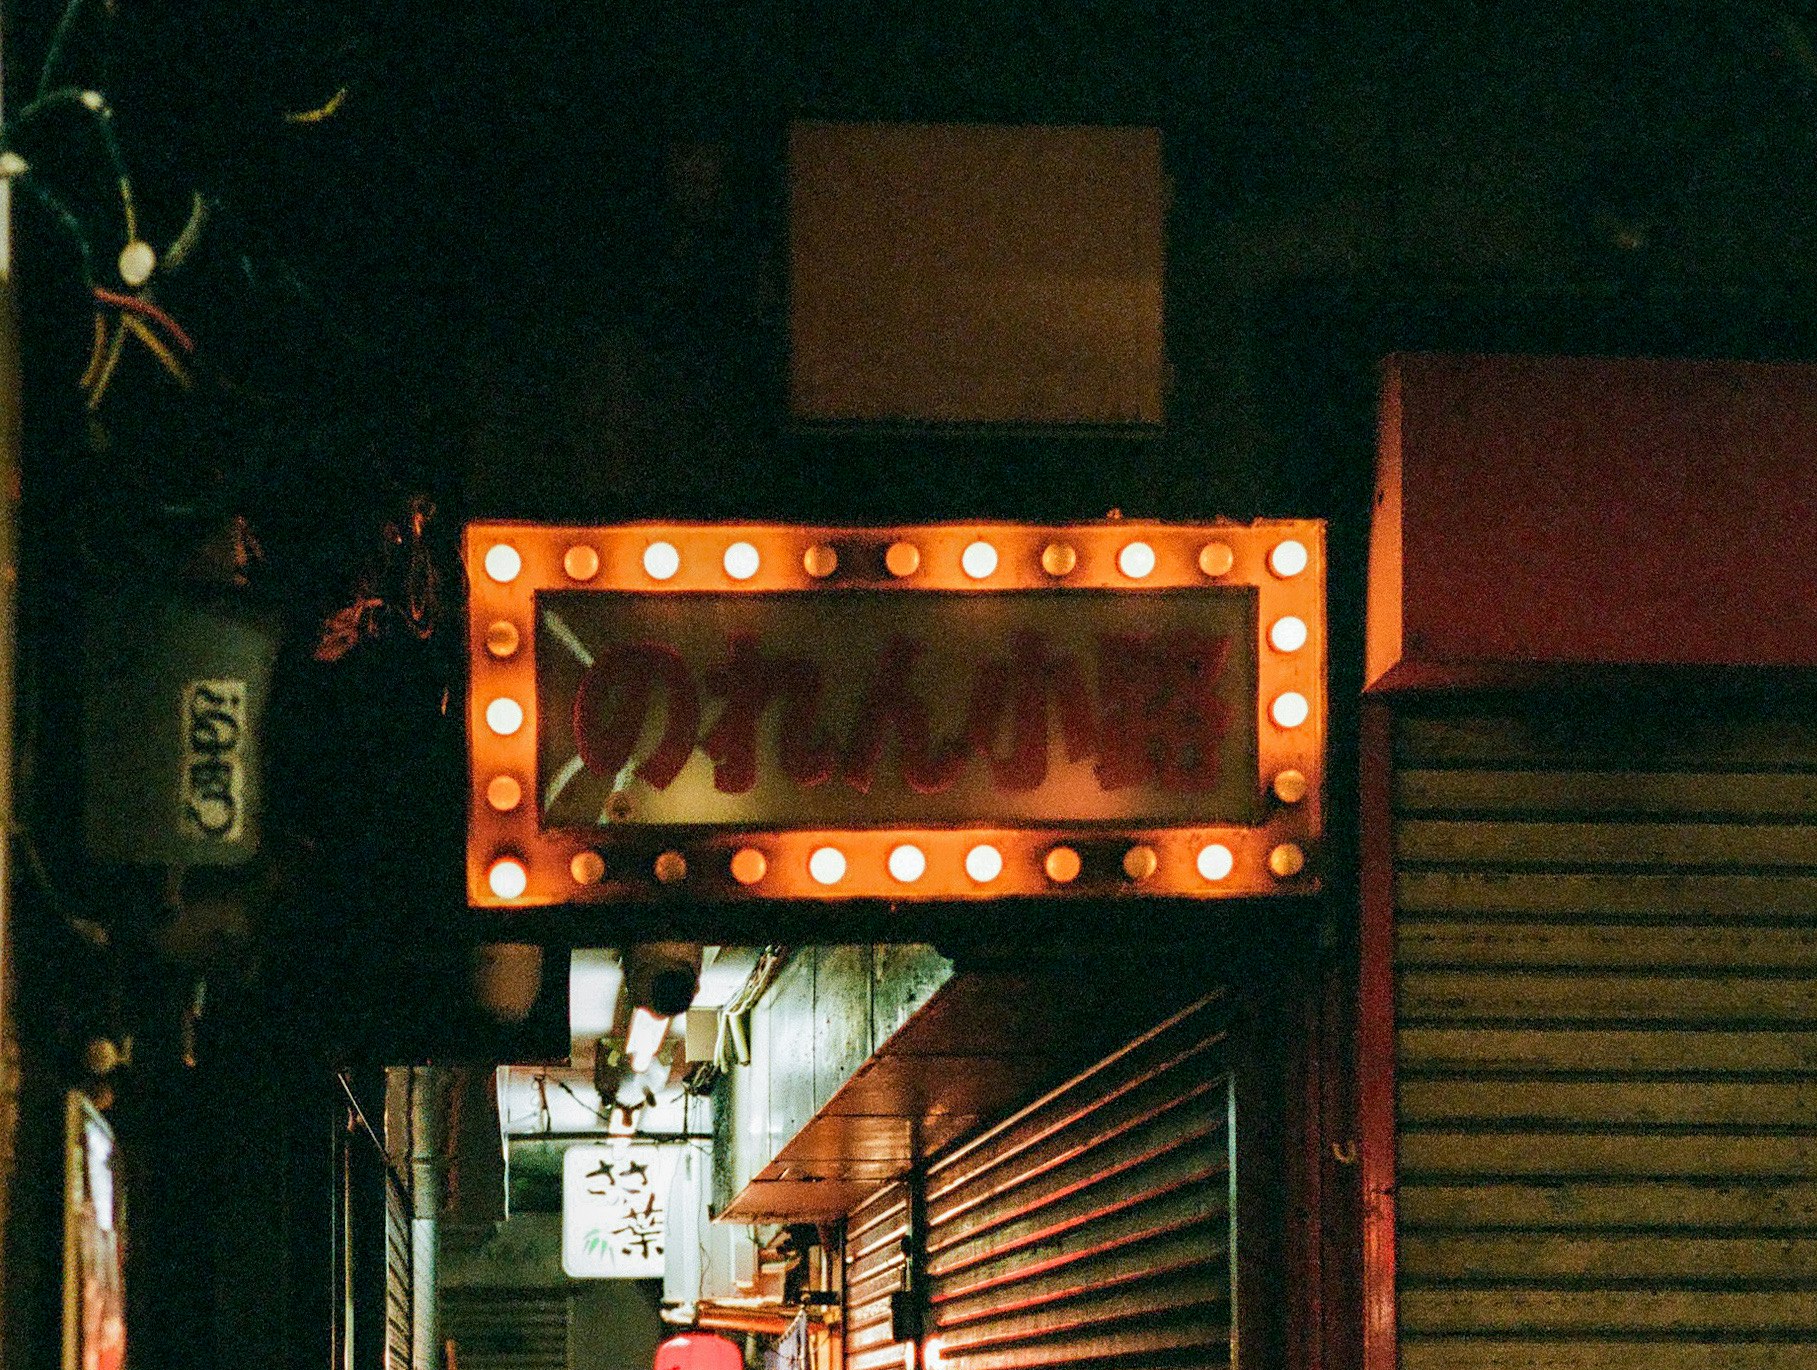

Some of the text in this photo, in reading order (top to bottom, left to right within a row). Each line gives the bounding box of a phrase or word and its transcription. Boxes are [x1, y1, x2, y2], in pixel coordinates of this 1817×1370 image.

[573, 631, 1233, 794] のれん小路
